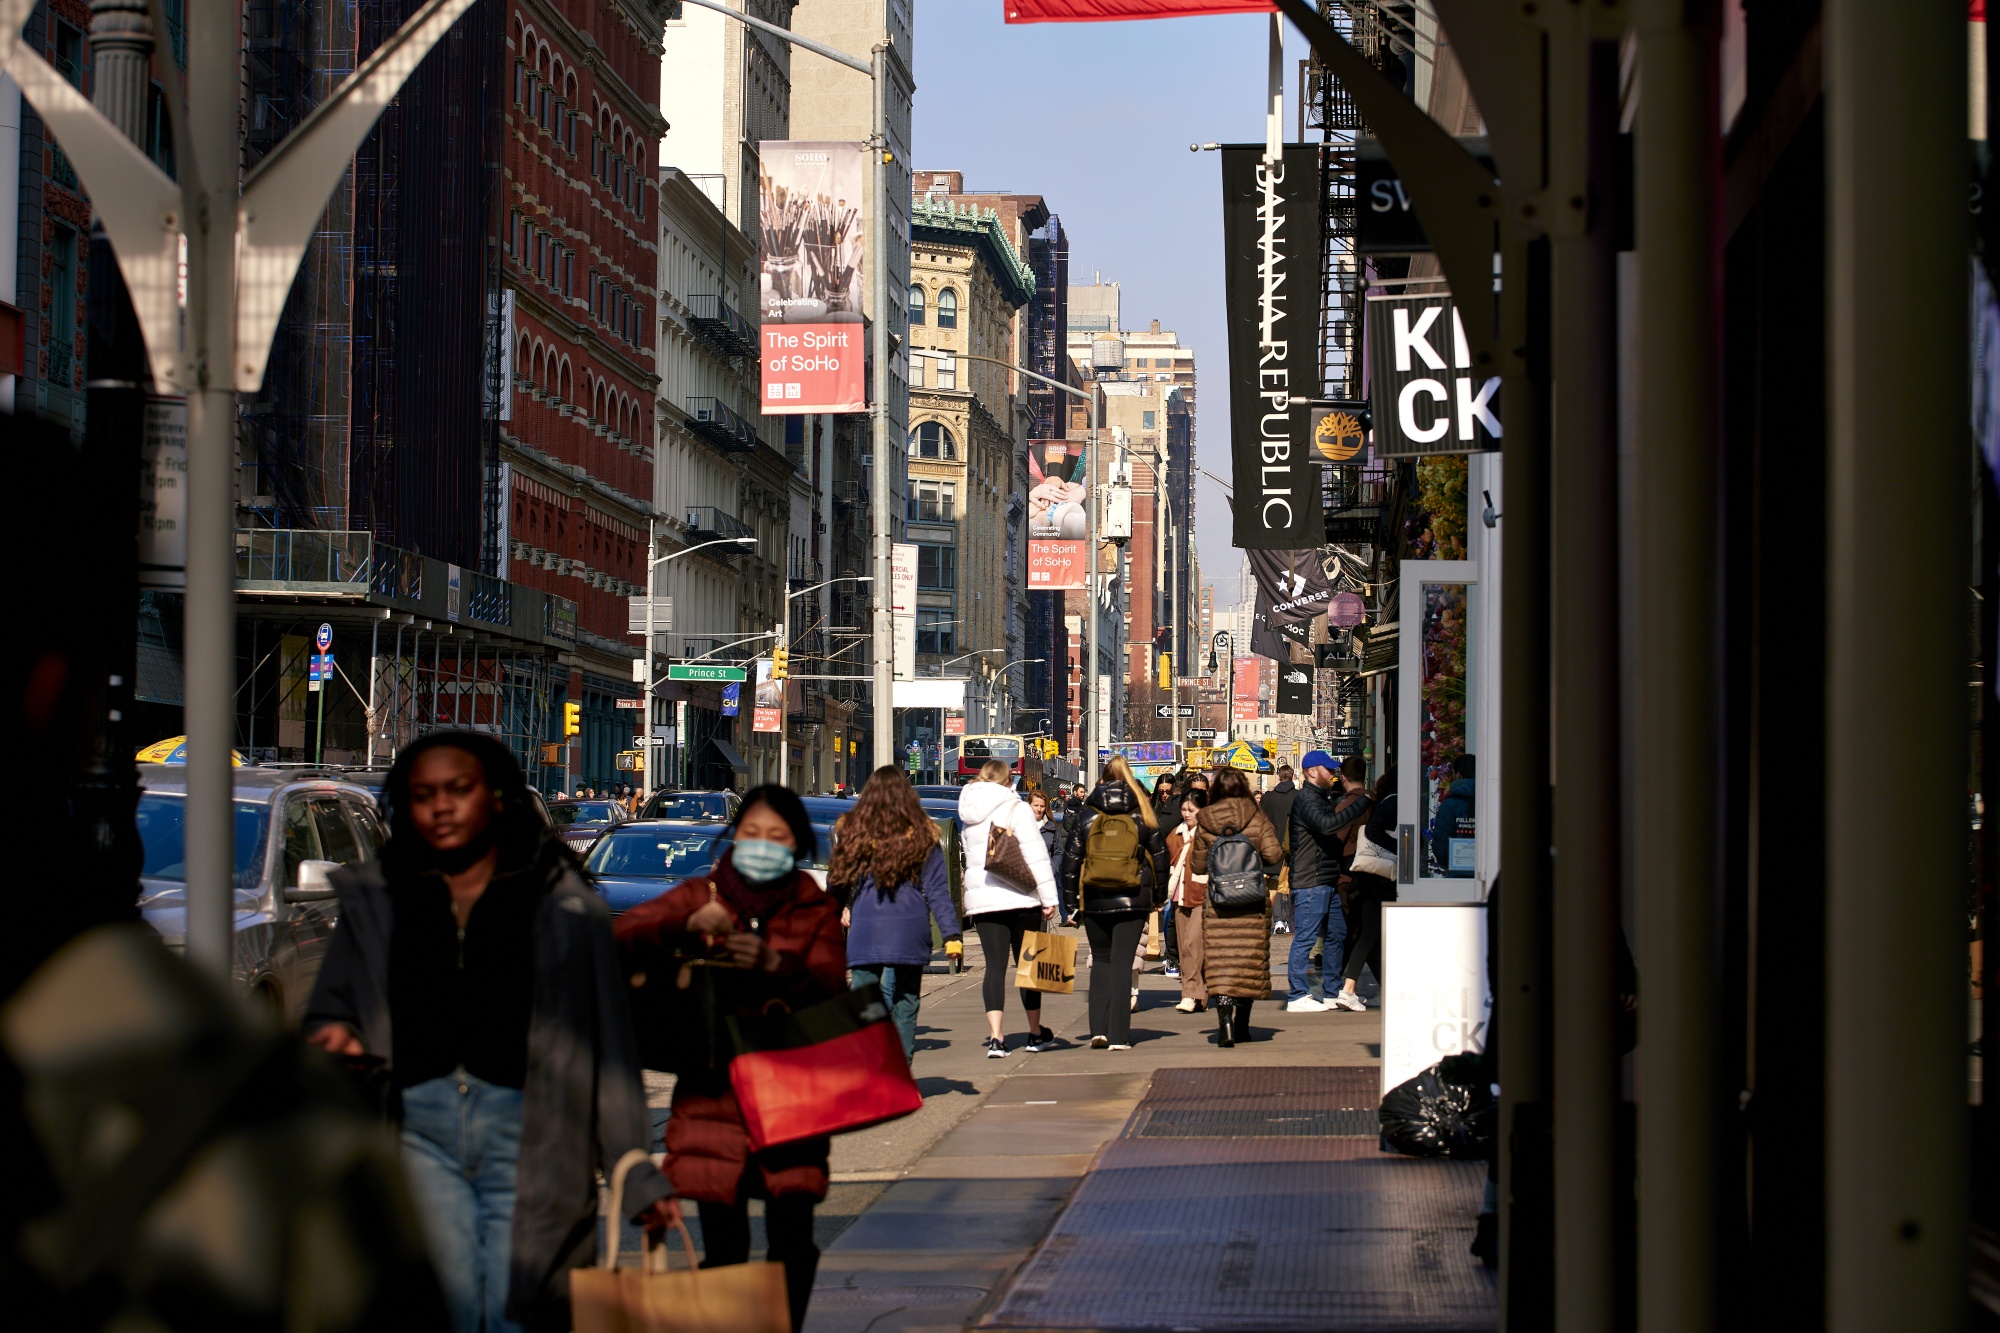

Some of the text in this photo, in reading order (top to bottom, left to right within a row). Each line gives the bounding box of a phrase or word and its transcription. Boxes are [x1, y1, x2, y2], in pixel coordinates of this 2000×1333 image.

[794, 152, 827, 161] SOHO
[1256, 163, 1288, 332] BANANA
[768, 298, 818, 307] Celebrating
[768, 310, 782, 318] Art
[766, 332, 848, 351] The Spirit
[1393, 306, 1471, 372] KI
[770, 355, 840, 372] of SoHo
[1398, 376, 1503, 444] CK
[147, 422, 188, 433] metere
[1258, 339, 1292, 528] REPUBLIC
[146, 435, 186, 449] parking
[164, 457, 188, 472] Frid
[1031, 544, 1077, 555] The Spirit
[1033, 557, 1072, 566] of SoHo
[1272, 590, 1329, 613] CONVERSE
[689, 669, 715, 677] Prince
[723, 699, 738, 707] GU
[1037, 961, 1060, 982] NIKE
[1432, 1022, 1486, 1053] CK
